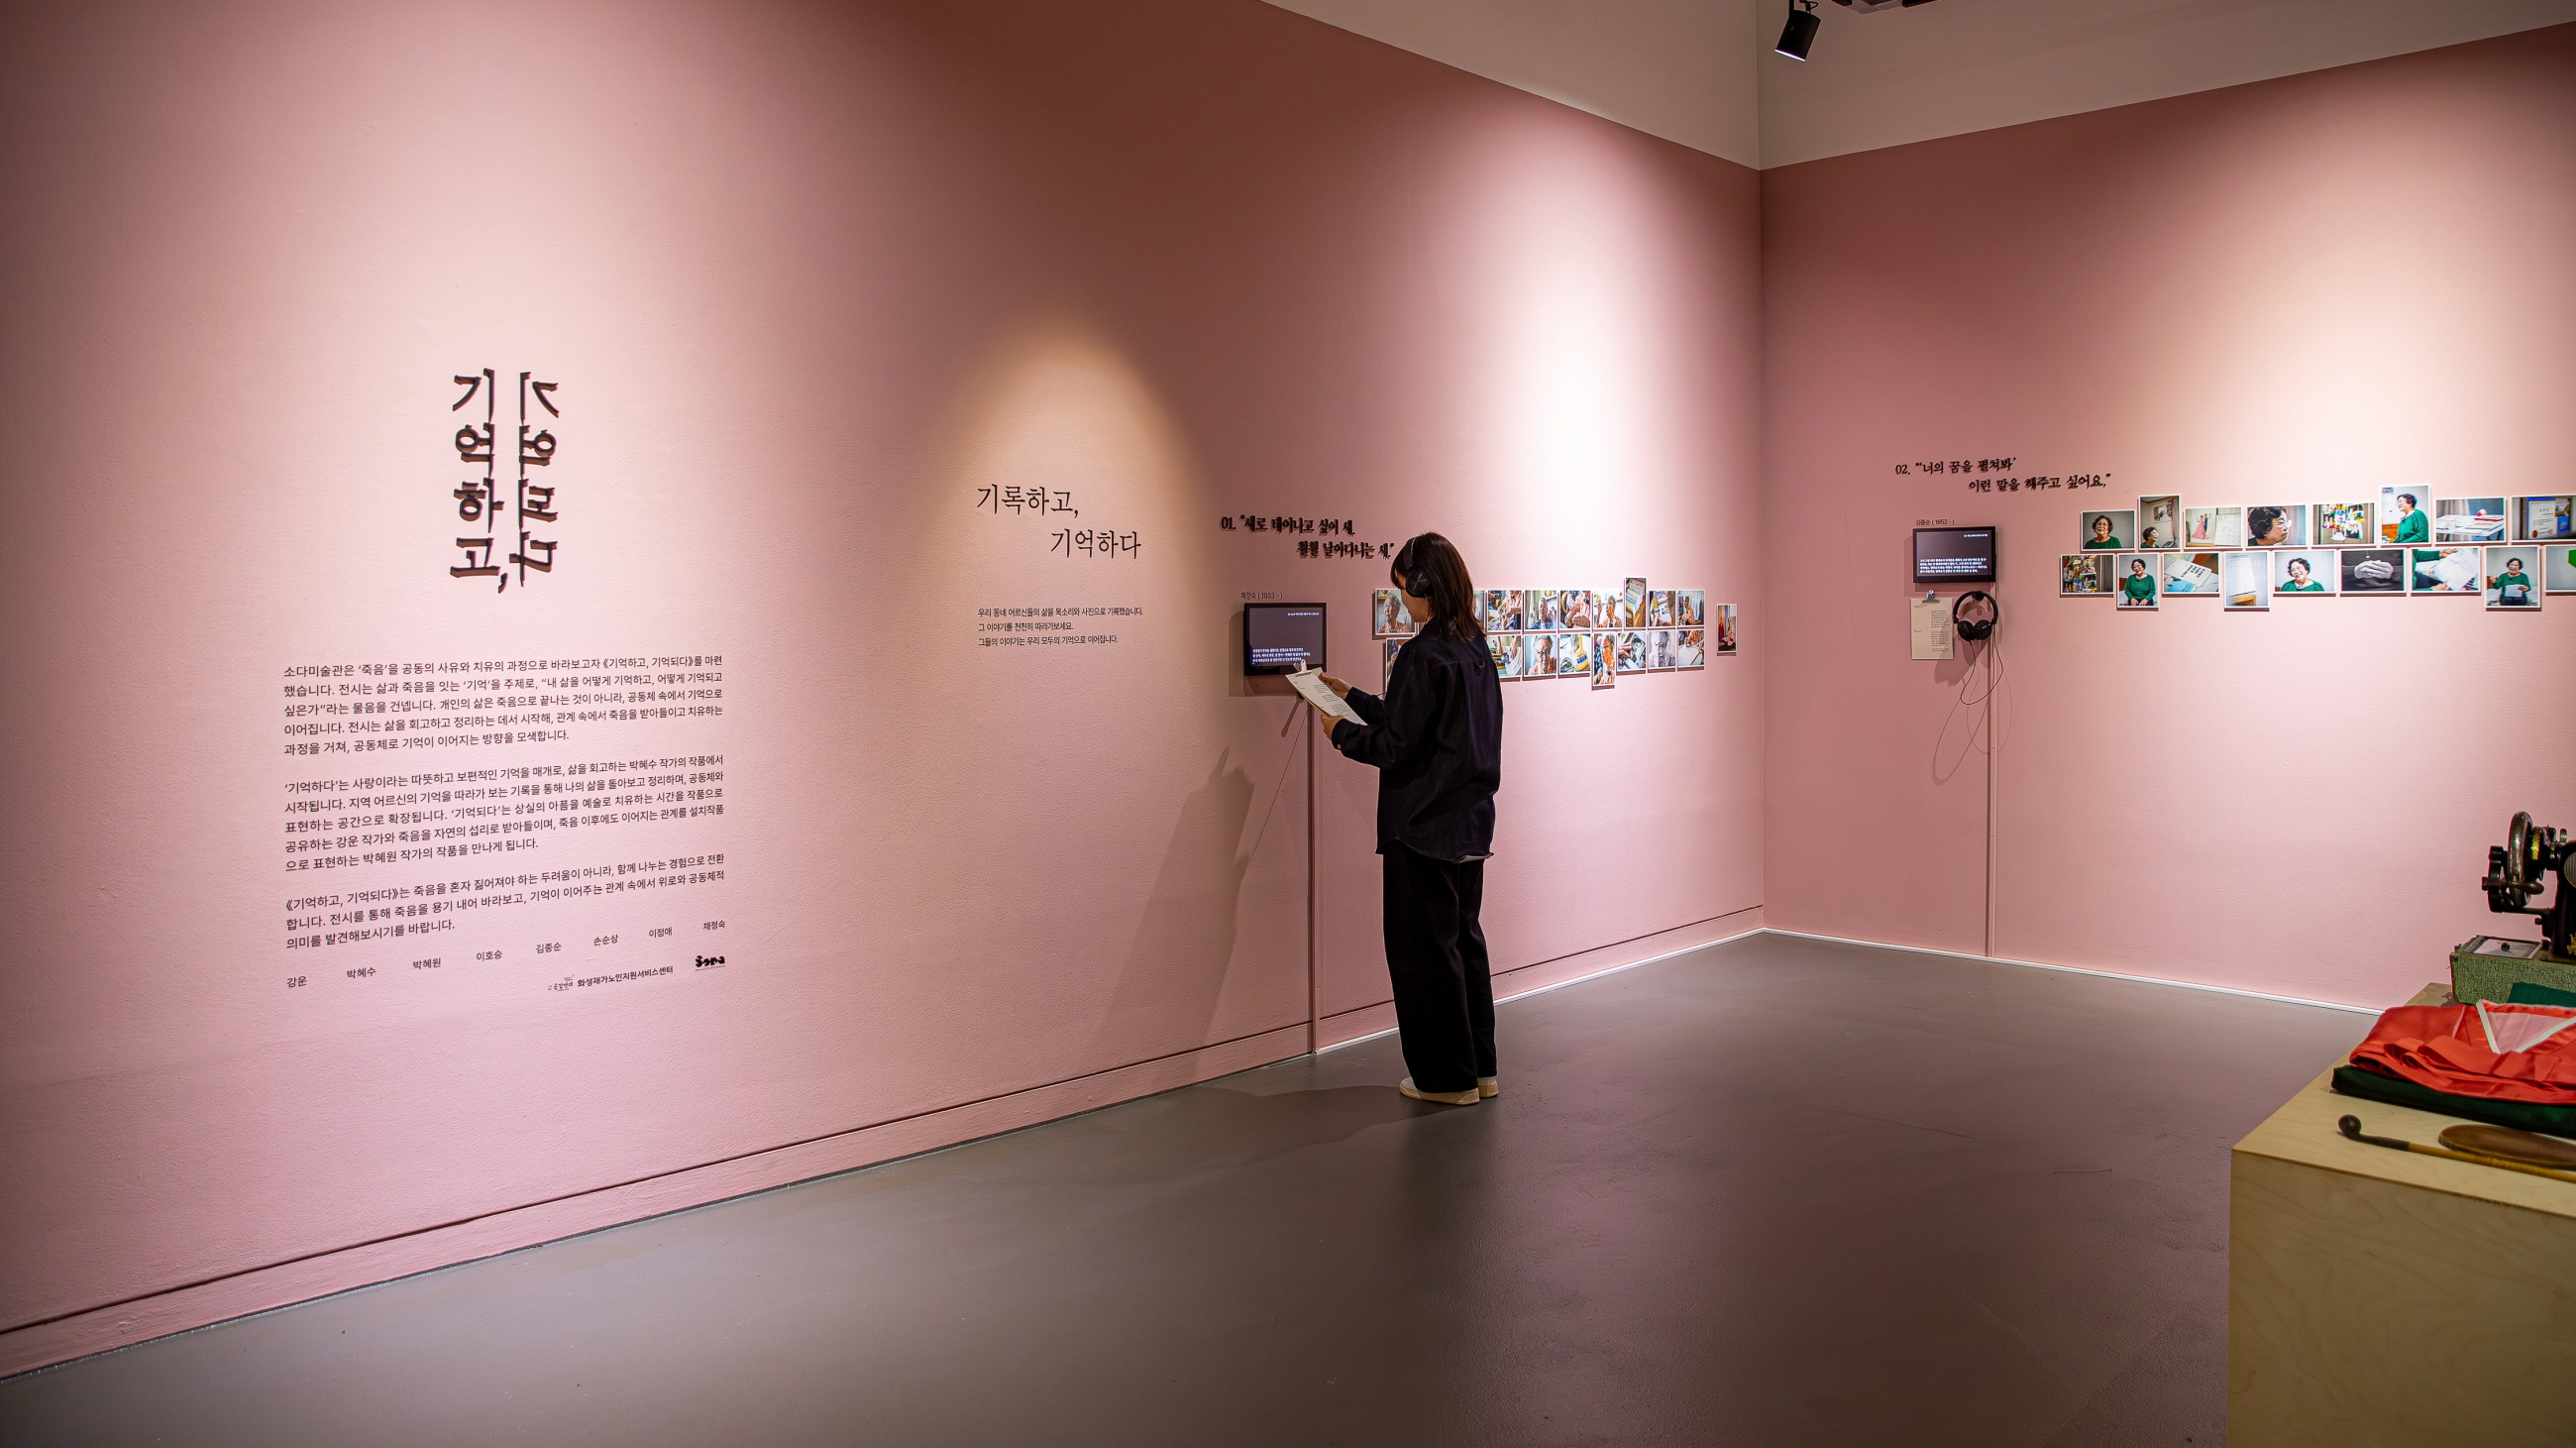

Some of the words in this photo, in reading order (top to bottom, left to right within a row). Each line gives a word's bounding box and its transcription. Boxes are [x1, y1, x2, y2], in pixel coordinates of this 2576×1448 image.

[450, 368, 508, 594] 기억하고,
[1894, 464, 1911, 476] 02.
[1949, 460, 1974, 474] 꿈을
[1968, 479, 1991, 493] 이런
[1995, 478, 2021, 492] 말을
[2025, 476, 2062, 492] 해주고
[977, 484, 1079, 519] 기록하고,
[1221, 516, 1236, 530] 01.
[1271, 516, 1315, 534] 태어나고
[1318, 517, 1339, 536] 싶어
[1050, 527, 1141, 559] 기억하다
[1323, 541, 1376, 559] 날아다니는
[977, 608, 992, 618] 우리
[993, 608, 1008, 618] 동네
[1008, 608, 1040, 617] 어르신들의
[1040, 607, 1054, 617] 삶을
[1055, 607, 1081, 617] 목소리와
[1081, 607, 1107, 616] 사진으로
[1107, 607, 1144, 616] 기록했습니다.
[978, 622, 986, 632] 그
[986, 621, 1014, 632] 이야기를
[1014, 621, 1033, 632] 천천히
[1034, 621, 1074, 631] 따라가보세요.
[978, 637, 999, 647] 그들의
[999, 636, 1026, 647] 이야기는
[1026, 635, 1040, 646] 우리
[1040, 635, 1060, 646] 모두의
[1061, 635, 1087, 645] 기억으로
[1087, 634, 1119, 644] 이어집니다.
[283, 664, 356, 678] 소다미술관은
[401, 662, 435, 675] 공동의
[437, 661, 471, 674] 사유와
[473, 660, 504, 673] 치유의
[506, 659, 549, 672] 과정으로
[551, 658, 601, 671] 바라보고자
[704, 654, 722, 666] 마련
[283, 684, 335, 698] 했습니다.
[338, 683, 374, 696] 전시는
[376, 682, 399, 695] 삶과
[401, 680, 436, 694] 죽음을
[438, 680, 461, 693] 잇는
[503, 678, 538, 691] 주제로,
[560, 676, 580, 689] 삶을
[582, 675, 611, 687] 어떻게
[613, 674, 655, 687] 기억하고,
[657, 673, 686, 685] 어떻게
[687, 672, 723, 684] 기억되고
[352, 701, 387, 715] 물음을
[389, 699, 437, 713] 건넵니다.
[439, 698, 471, 711] 개인의
[473, 697, 494, 710] 삶은
[496, 696, 538, 708] 죽음으로
[539, 694, 571, 707] 끝나는
[572, 693, 591, 706] 것이
[593, 692, 625, 705] 아니라,
[627, 691, 656, 703] 공동체
[657, 689, 686, 702] 속에서
[687, 688, 723, 701] 기억으로
[283, 722, 345, 737] 이어집니다.
[348, 721, 381, 733] 전시는
[383, 719, 406, 732] 삶을
[408, 717, 452, 730] 회고하고
[454, 715, 495, 728] 정리하는
[497, 714, 518, 726] 데서
[520, 712, 554, 725] 시작해,
[556, 711, 576, 724] 관계
[578, 710, 607, 723] 속에서
[608, 709, 638, 721] 죽음을
[639, 707, 687, 720] 받아들이고
[688, 705, 724, 718] 치유하는
[352, 775, 409, 790] 사랑이라는
[411, 772, 455, 786] 따뜻하고
[456, 768, 497, 783] 보편적인
[499, 766, 530, 780] 기억을
[532, 765, 566, 778] 매개로,
[567, 763, 588, 776] 삶을
[589, 760, 627, 774] 회고하는
[629, 758, 658, 771] 박혜수
[659, 756, 687, 769] 작가의
[688, 753, 723, 767] 작품에서
[284, 798, 347, 815] 시작됩니다.
[349, 796, 371, 810] 지역
[374, 792, 417, 808] 어르신의
[420, 790, 453, 804] 기억을
[454, 787, 485, 801] 따라가
[487, 787, 508, 799] 보는
[510, 784, 541, 797] 기록을
[543, 782, 563, 795] 통해
[565, 780, 585, 793] 나의
[587, 779, 606, 792] 삶을
[607, 777, 646, 790] 돌아보고
[647, 773, 687, 787] 정리하며,
[689, 770, 724, 784] 공동체와
[413, 882, 447, 897] 죽음을
[449, 879, 472, 894] 혼자
[474, 876, 515, 891] 짊어져야
[517, 873, 539, 887] 하는
[540, 868, 581, 883] 두려움이
[583, 864, 614, 879] 아니라,
[616, 862, 636, 875] 함께
[638, 859, 668, 872] 나누는
[669, 855, 705, 869] 경험으로
[706, 852, 725, 865] 전환
[285, 915, 326, 932] 합니다.
[329, 910, 365, 926] 전시를
[368, 907, 391, 922] 통해
[394, 903, 429, 918] 죽음을
[431, 900, 453, 914] 용기
[456, 897, 478, 911] 내어
[481, 893, 527, 908] 바라보고,
[529, 887, 560, 902] 기억이
[563, 884, 603, 898] 이어주는
[604, 880, 624, 894] 관계
[626, 877, 656, 891] 속에서
[658, 873, 687, 888] 위로와
[688, 869, 724, 884] 공동체적
[286, 935, 323, 949] 의미를
[325, 924, 405, 946] 발견해보시기를
[408, 918, 456, 935] 바랍니다.
[286, 975, 308, 989] 강운
[346, 966, 377, 980] 박혜수
[412, 956, 442, 970] 박혜원
[476, 948, 503, 962] 이호승
[535, 942, 562, 954] 김종순
[592, 933, 619, 947] 손순상
[648, 926, 673, 939] 이정애
[702, 919, 726, 931] 채정숙
[577, 965, 674, 987] 화성재가노인지원서비스센터
